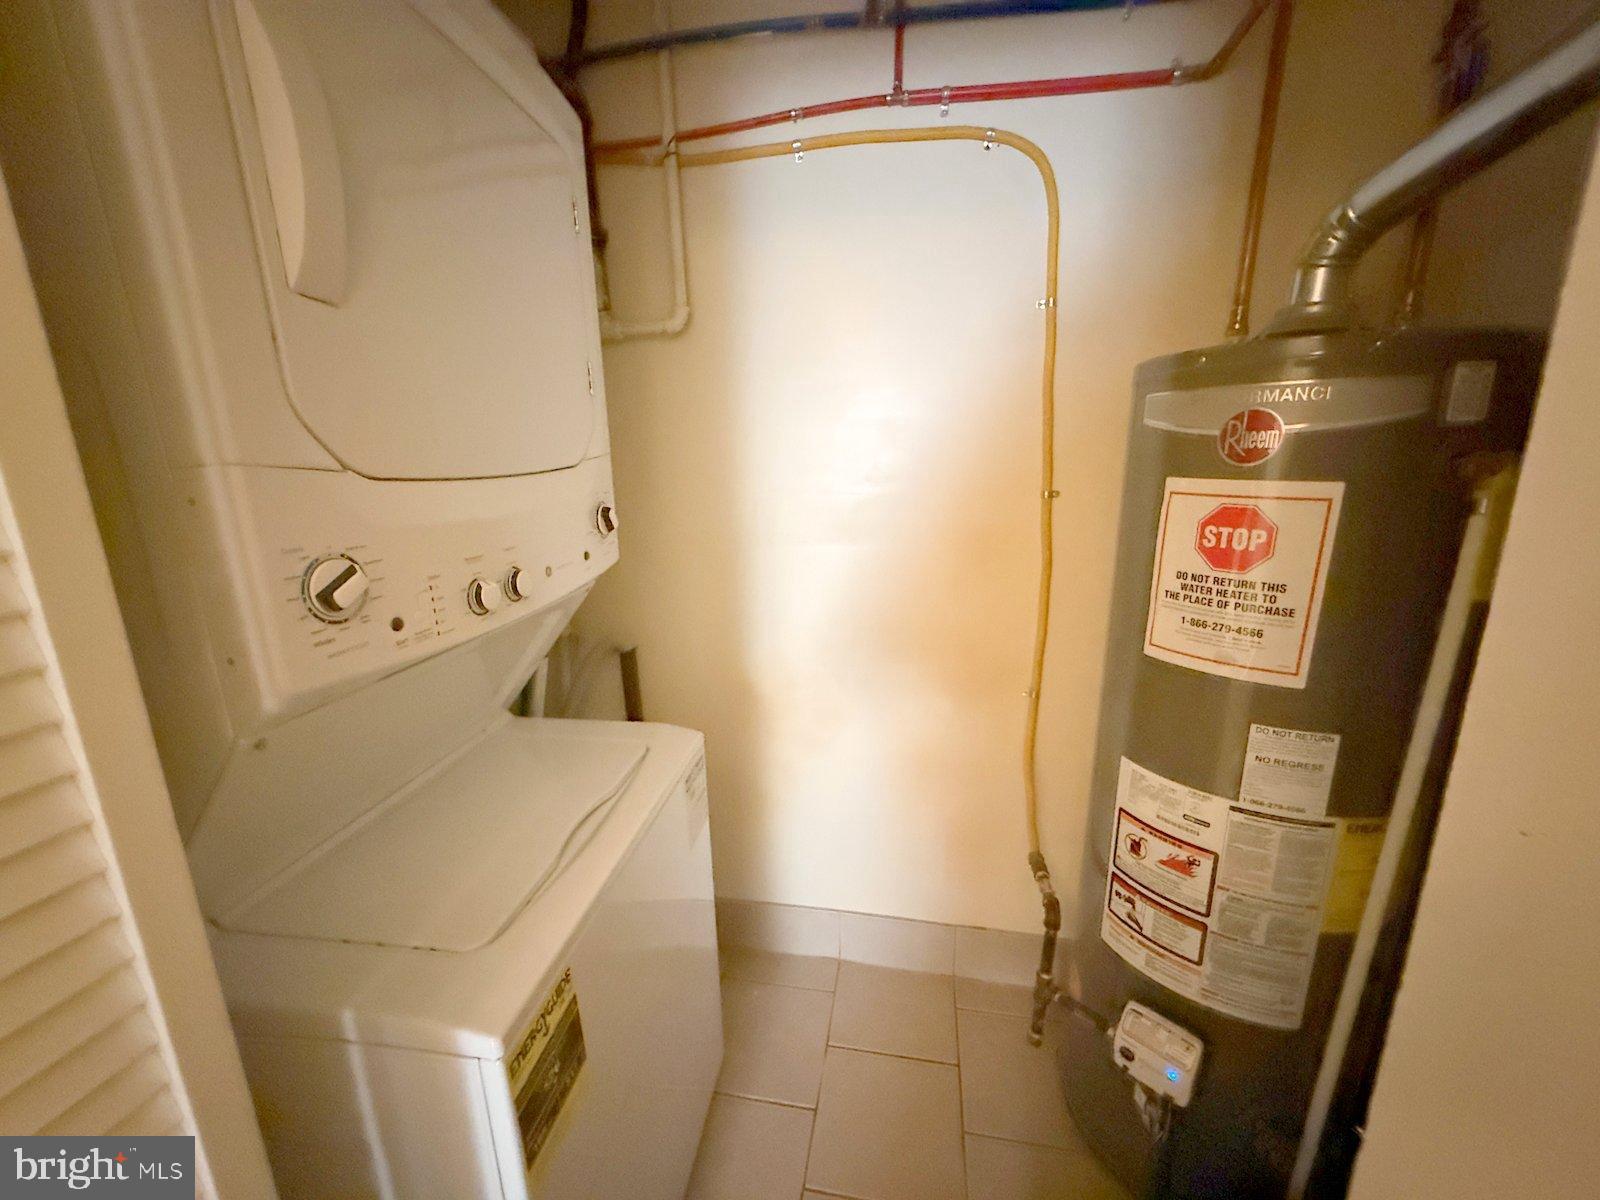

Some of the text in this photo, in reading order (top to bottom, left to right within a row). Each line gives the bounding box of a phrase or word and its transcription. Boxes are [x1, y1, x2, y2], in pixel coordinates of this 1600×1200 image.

[1224, 409, 1280, 456] Rheem
[1202, 525, 1267, 552] STOP
[1176, 571, 1288, 594] DO NOT RETURN THIS
[1180, 583, 1277, 604] WATER HEATER TO
[1165, 590, 1180, 600] THE
[1183, 594, 1213, 607] PLACE
[1217, 600, 1230, 609] OF
[1234, 602, 1296, 618] PURCHASE
[1181, 616, 1263, 638] 1-866-279-4566
[1255, 726, 1335, 743] DO NOT RETURN
[1255, 755, 1271, 764] NO
